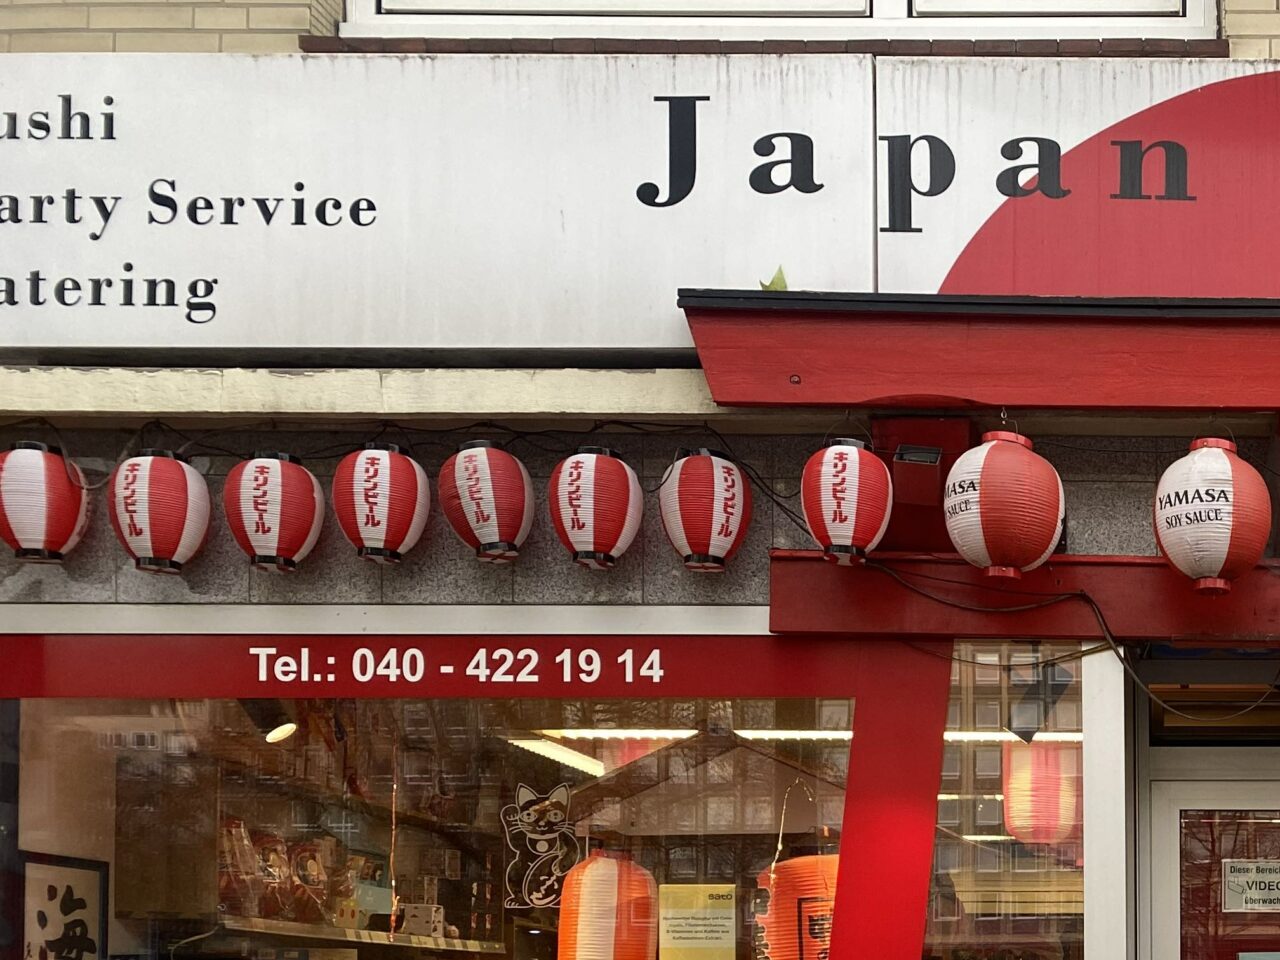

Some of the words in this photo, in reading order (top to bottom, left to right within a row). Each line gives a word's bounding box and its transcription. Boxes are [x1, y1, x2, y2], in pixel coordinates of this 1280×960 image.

[635, 95, 1197, 234] Japan
[147, 178, 377, 226] Service
[124, 463, 143, 537] キリンビール
[252, 465, 272, 535] キリンビール
[364, 456, 381, 527] キリンビール
[463, 454, 491, 524] キリンビール
[568, 460, 586, 530] キリンビール
[717, 466, 735, 538] キリンビール
[832, 452, 850, 523] キリンビール
[1158, 488, 1230, 510] YAMASA
[1165, 513, 1184, 530] SOY
[1185, 508, 1223, 525] SAUCE
[250, 647, 335, 684] Tel.:
[352, 648, 425, 684] 040
[466, 648, 540, 684] 422
[556, 648, 601, 684] 19
[617, 648, 664, 684] 14
[1229, 865, 1253, 874] Dieser
